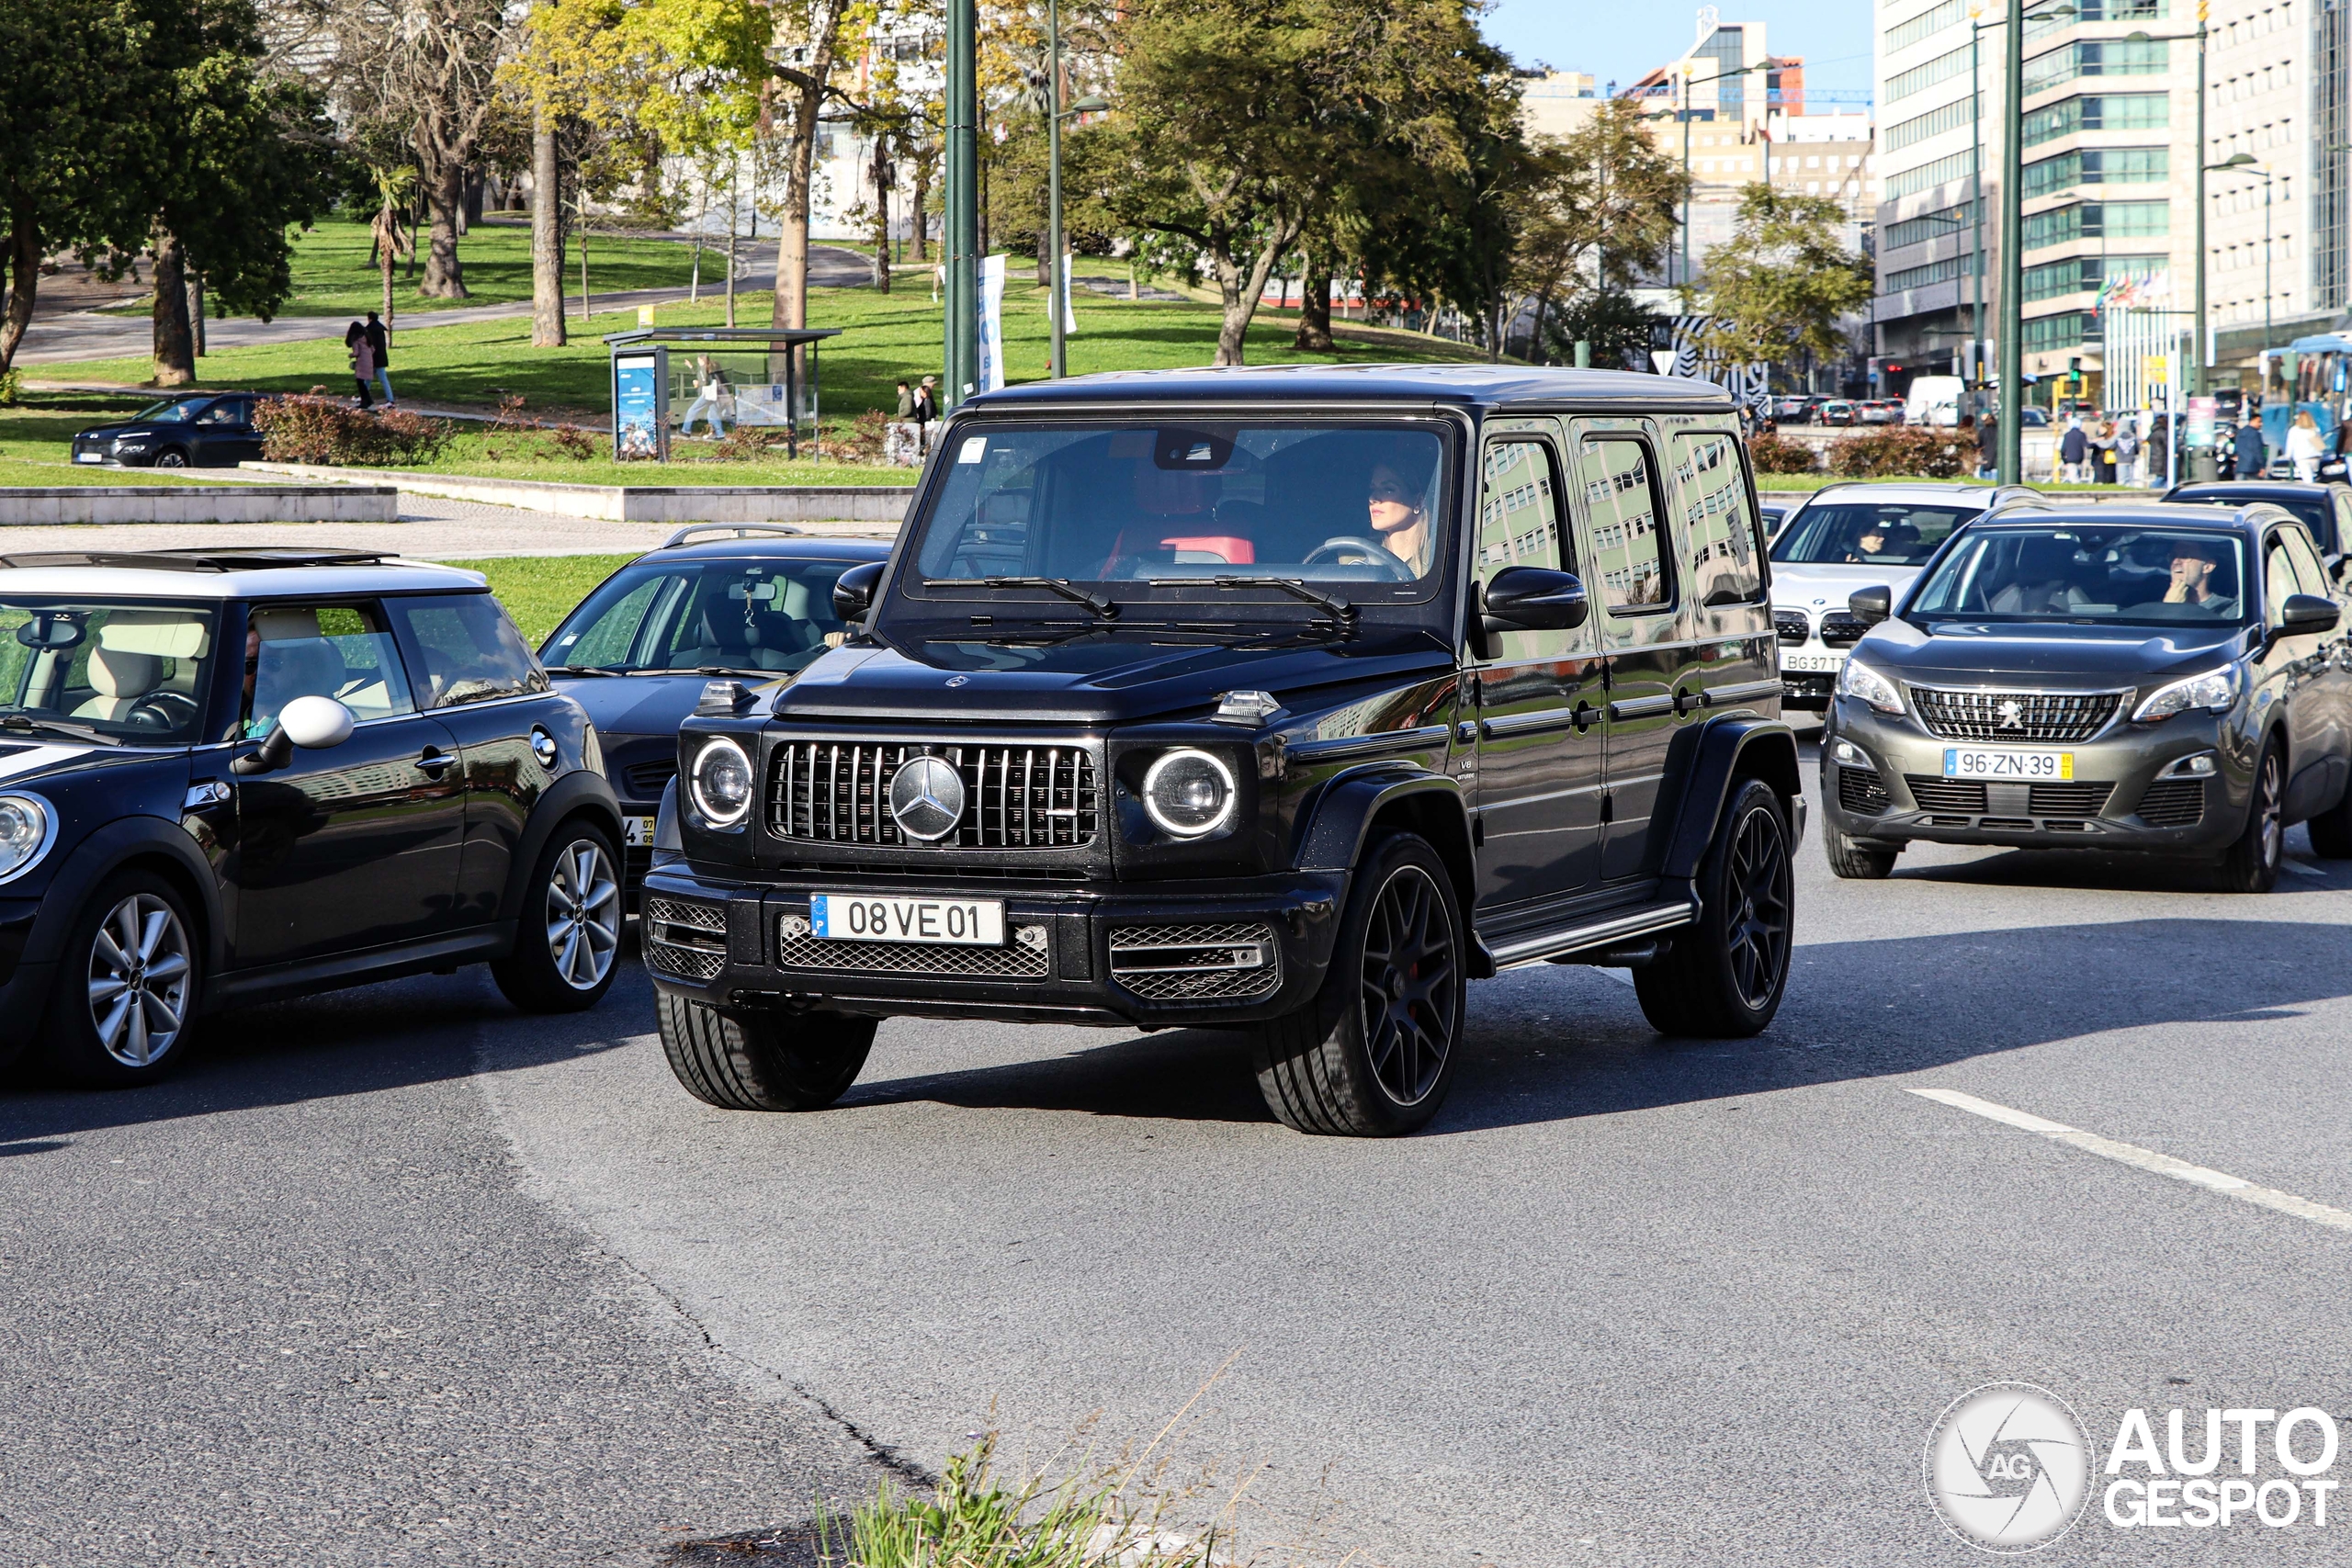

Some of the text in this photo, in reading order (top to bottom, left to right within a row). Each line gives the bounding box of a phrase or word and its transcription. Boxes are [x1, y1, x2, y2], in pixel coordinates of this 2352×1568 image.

[1460, 761, 1471, 770] V8
[643, 819, 653, 829] 07
[643, 835, 653, 843] 09
[816, 920, 824, 930] P
